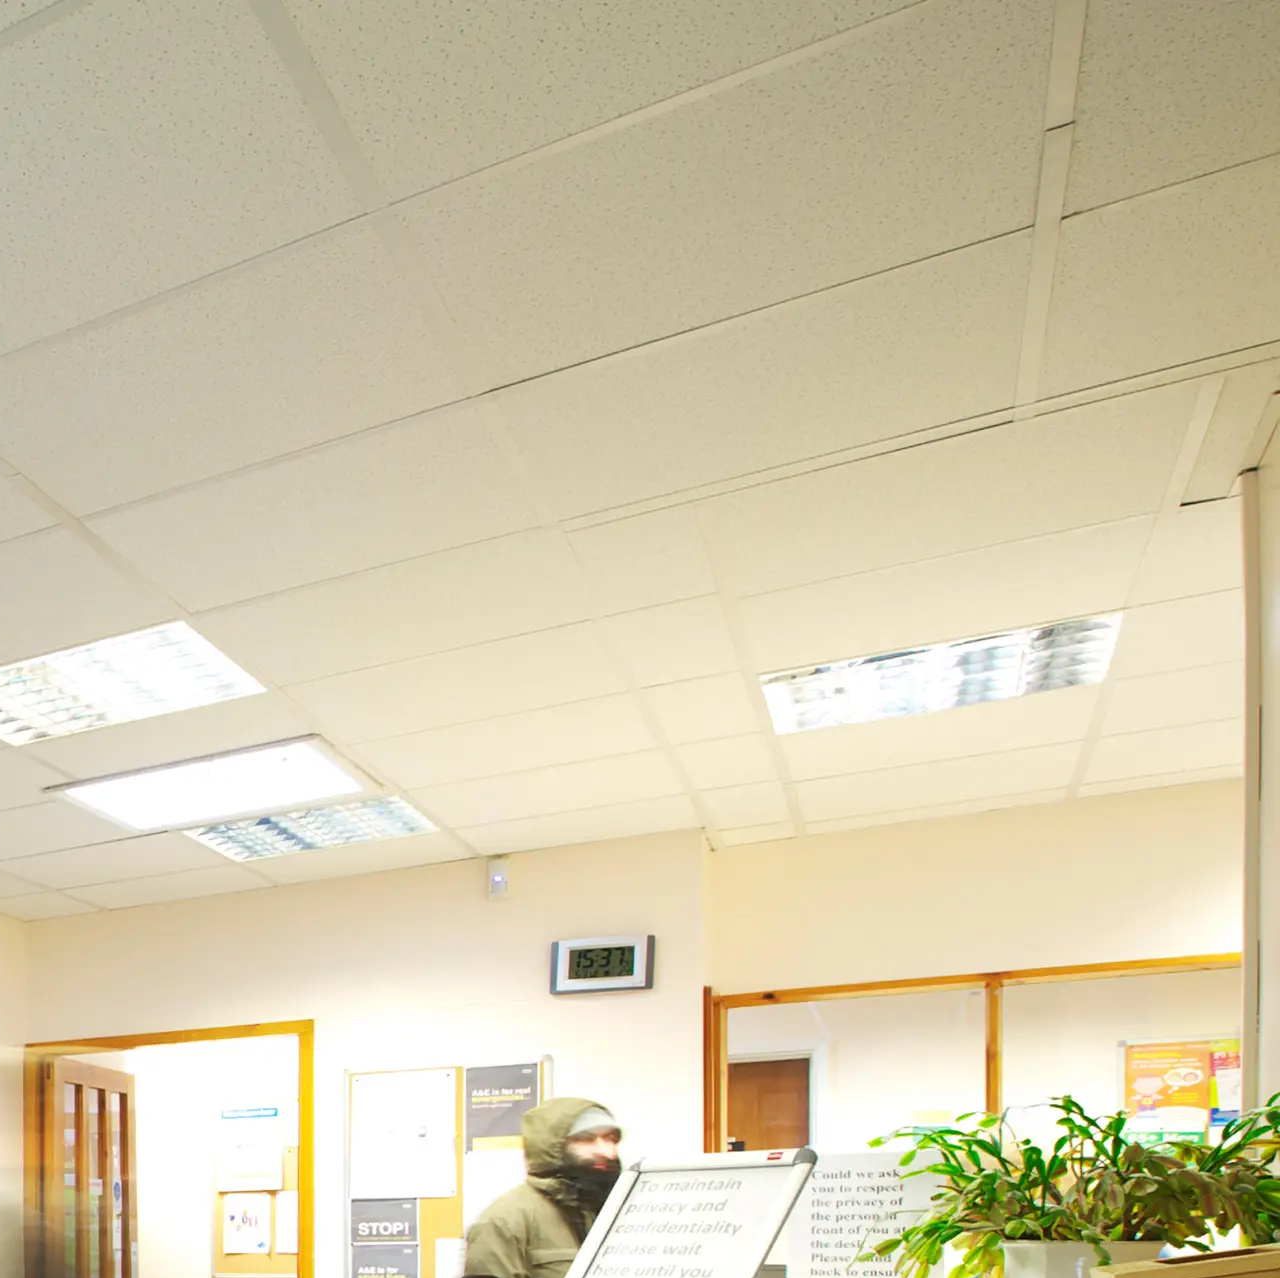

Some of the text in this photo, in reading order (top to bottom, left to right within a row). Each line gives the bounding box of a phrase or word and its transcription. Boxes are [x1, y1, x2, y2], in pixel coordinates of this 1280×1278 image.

[811, 1170, 851, 1179] Could
[878, 1169, 901, 1178] ask
[640, 1177, 743, 1192] To maintain
[811, 1184, 904, 1196] you to respect
[624, 1199, 729, 1216] privacy and
[811, 1197, 904, 1209] the privacy of
[811, 1211, 831, 1221] the
[835, 1213, 880, 1223] person
[357, 1222, 410, 1235] STOP!
[614, 1220, 743, 1236] confidentiality
[811, 1225, 844, 1235] front
[847, 1225, 863, 1234] of
[864, 1226, 889, 1237] you
[810, 1239, 831, 1249] the
[602, 1243, 703, 1258] please wait
[811, 1252, 851, 1263] Please
[592, 1264, 714, 1278] here until you
[810, 1267, 841, 1276] back
[845, 1268, 859, 1276] to
